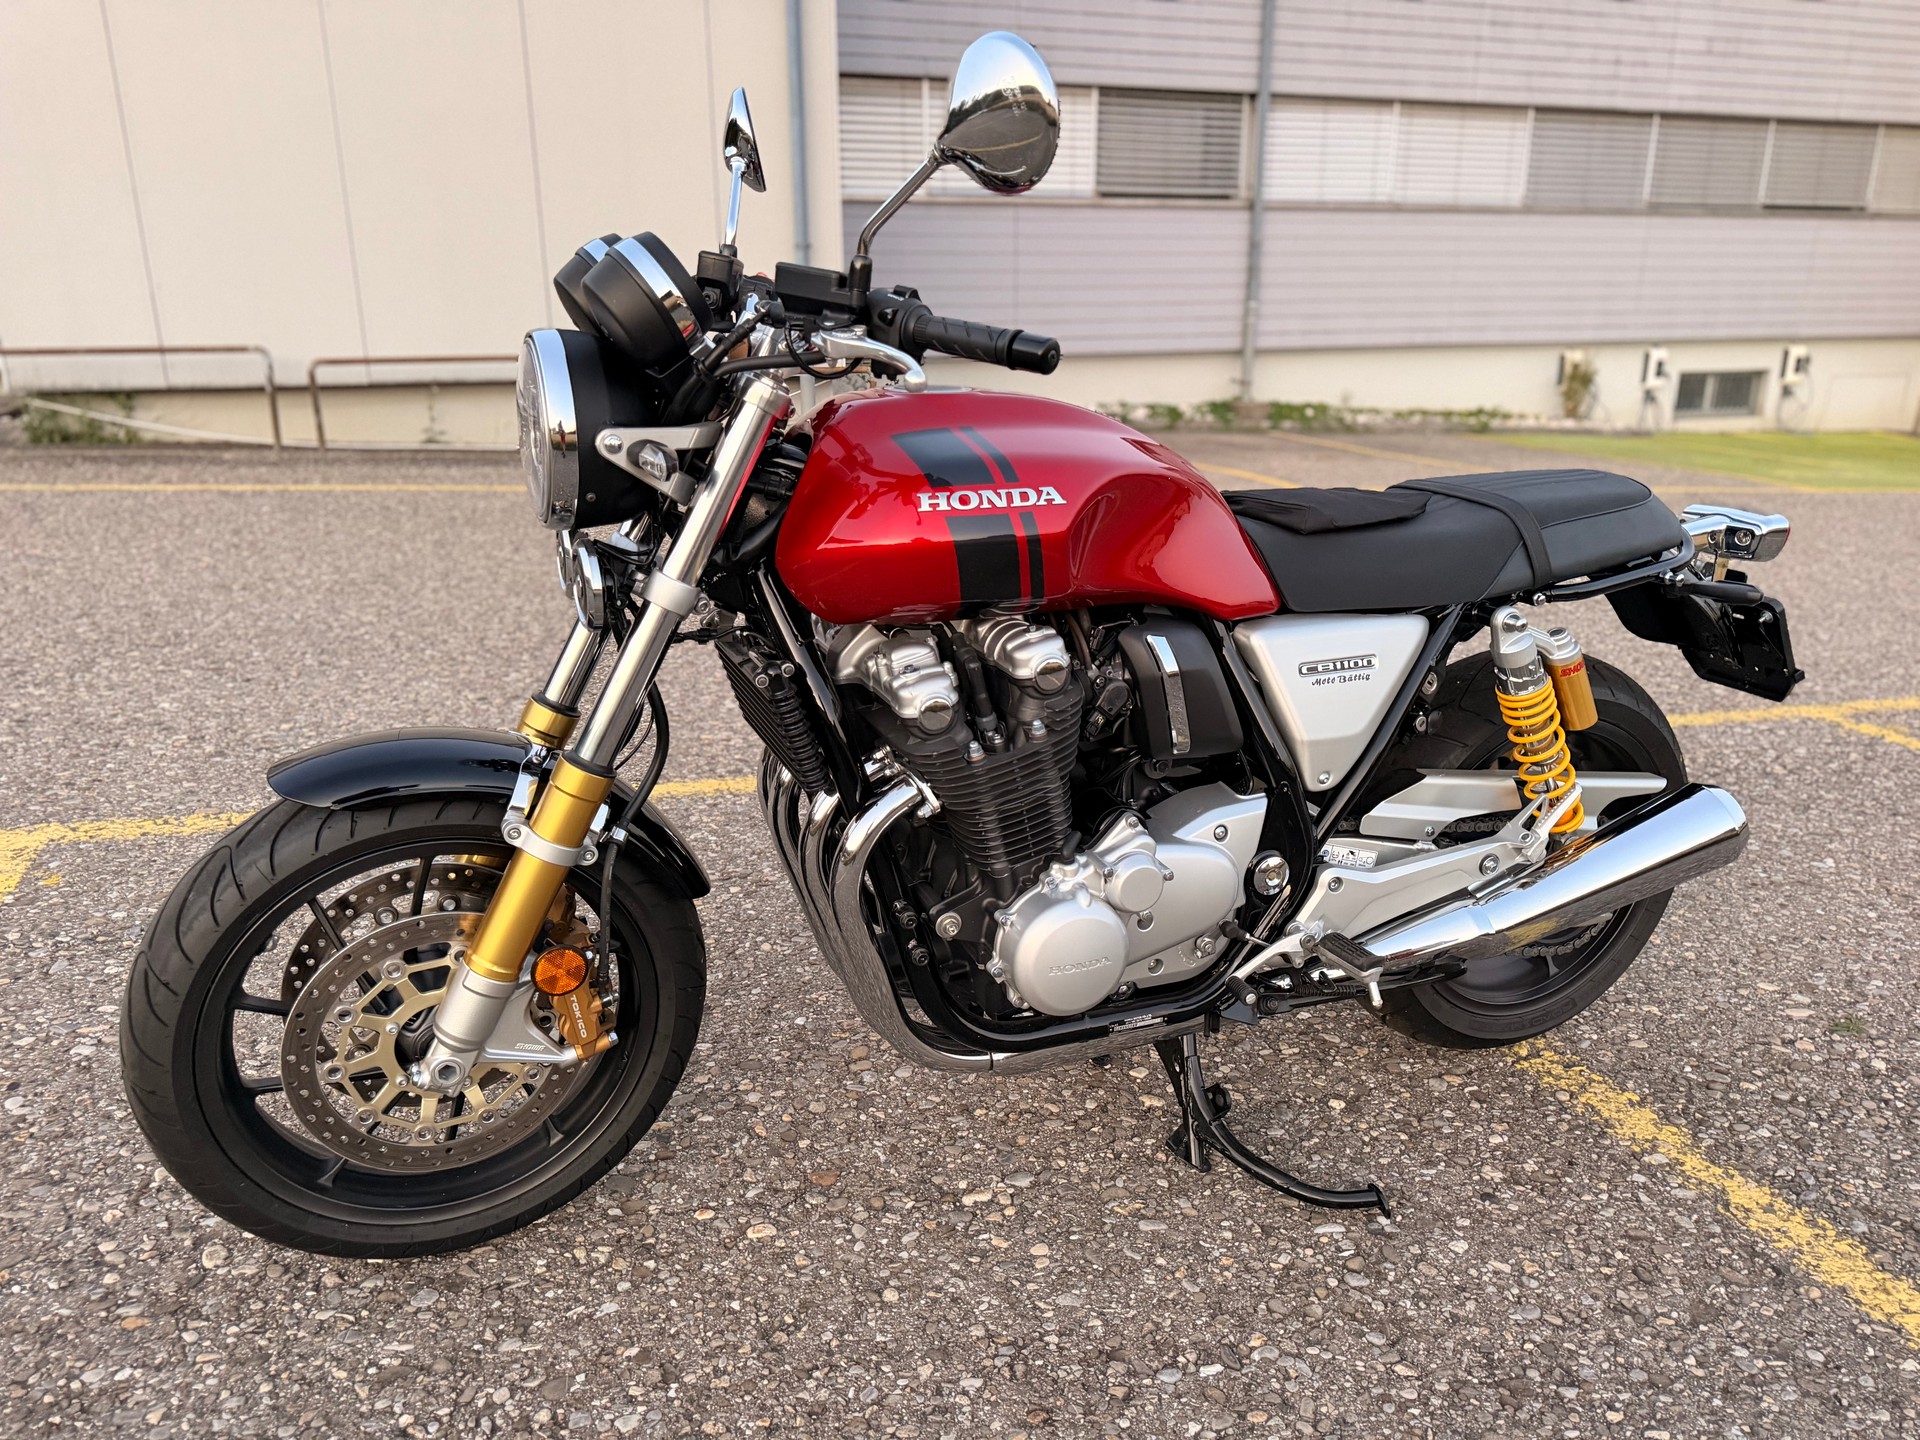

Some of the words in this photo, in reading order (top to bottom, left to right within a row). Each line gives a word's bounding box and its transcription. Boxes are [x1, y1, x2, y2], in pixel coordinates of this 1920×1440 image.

[917, 486, 1067, 512] HONDA
[1300, 657, 1376, 674] CB1100
[1311, 677, 1336, 686] Moto
[1337, 673, 1371, 684] Bättig
[1048, 956, 1112, 976] HONDA
[570, 994, 587, 1038] TOKICO
